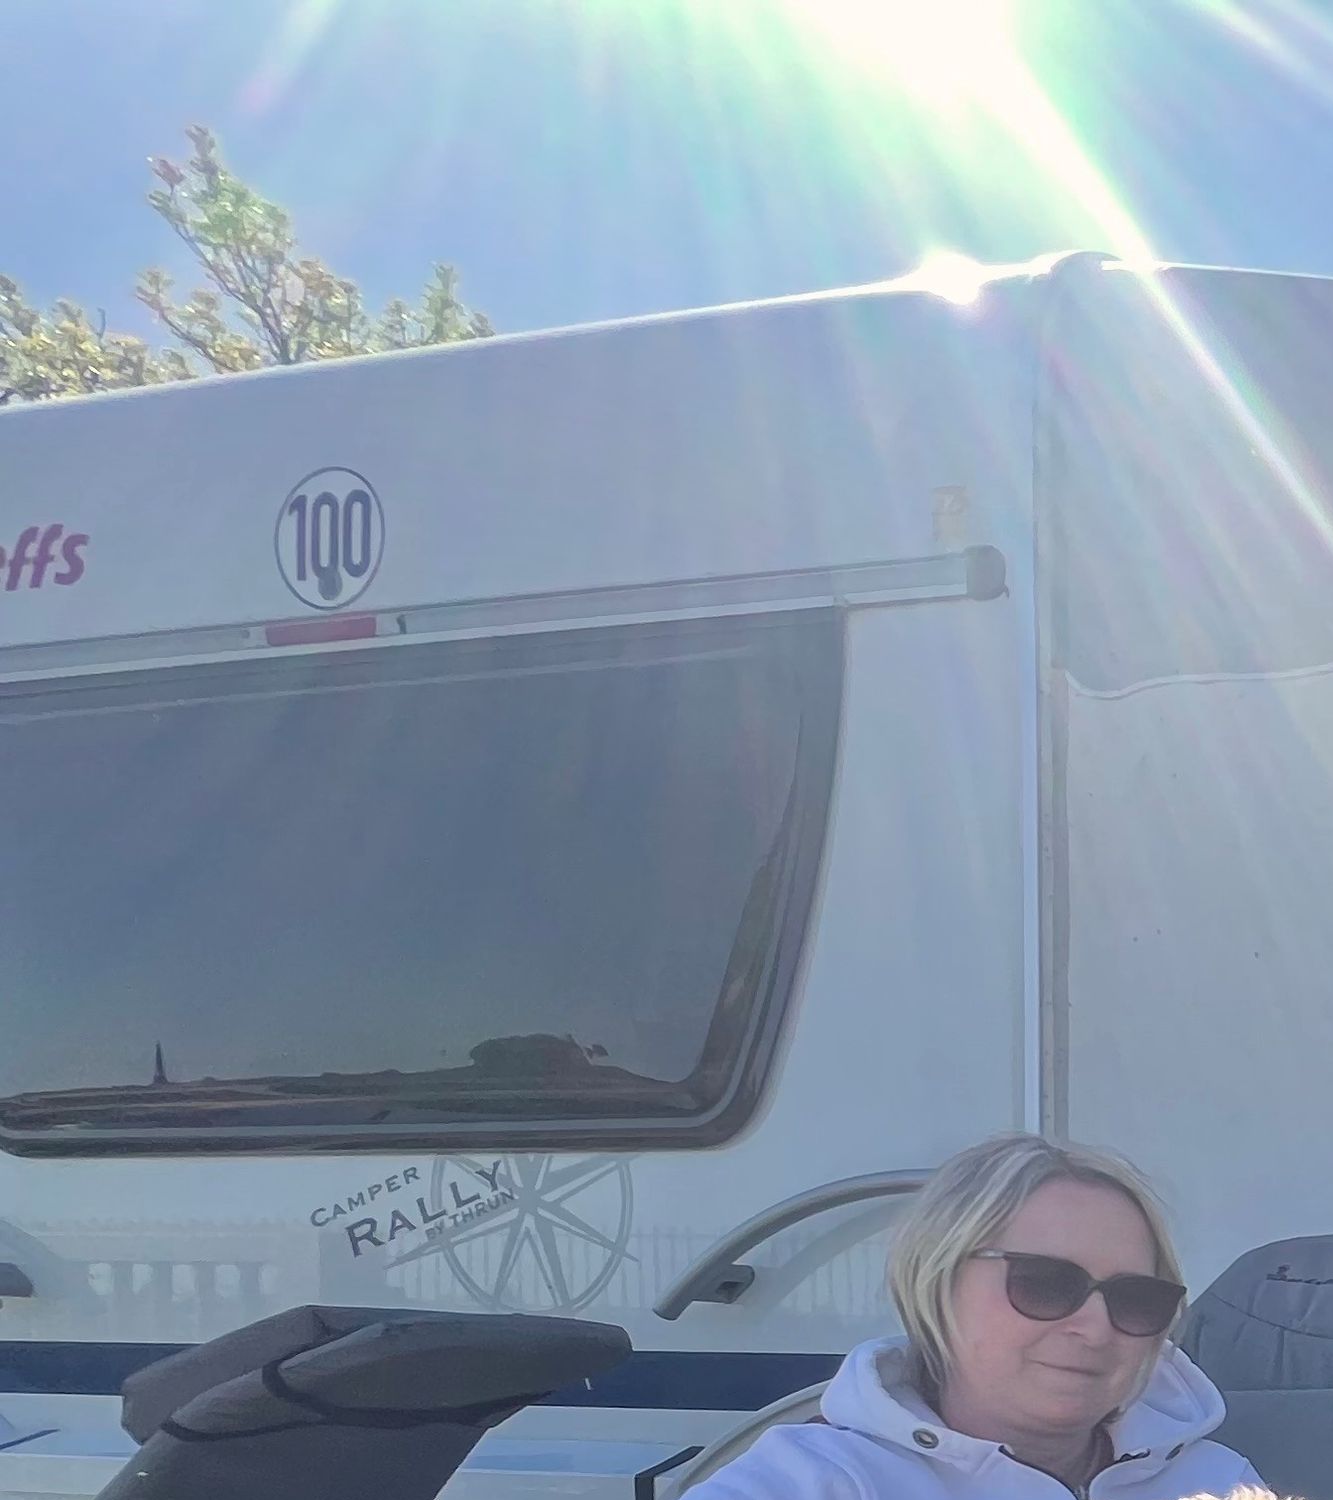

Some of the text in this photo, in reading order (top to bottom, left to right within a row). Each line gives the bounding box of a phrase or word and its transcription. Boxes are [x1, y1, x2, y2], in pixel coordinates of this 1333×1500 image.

[0, 523, 90, 591] ffs
[288, 489, 371, 581] 100
[310, 1166, 420, 1227] CAMPER
[345, 1160, 502, 1258] RALLY
[425, 1188, 515, 1241] BY THRUN
